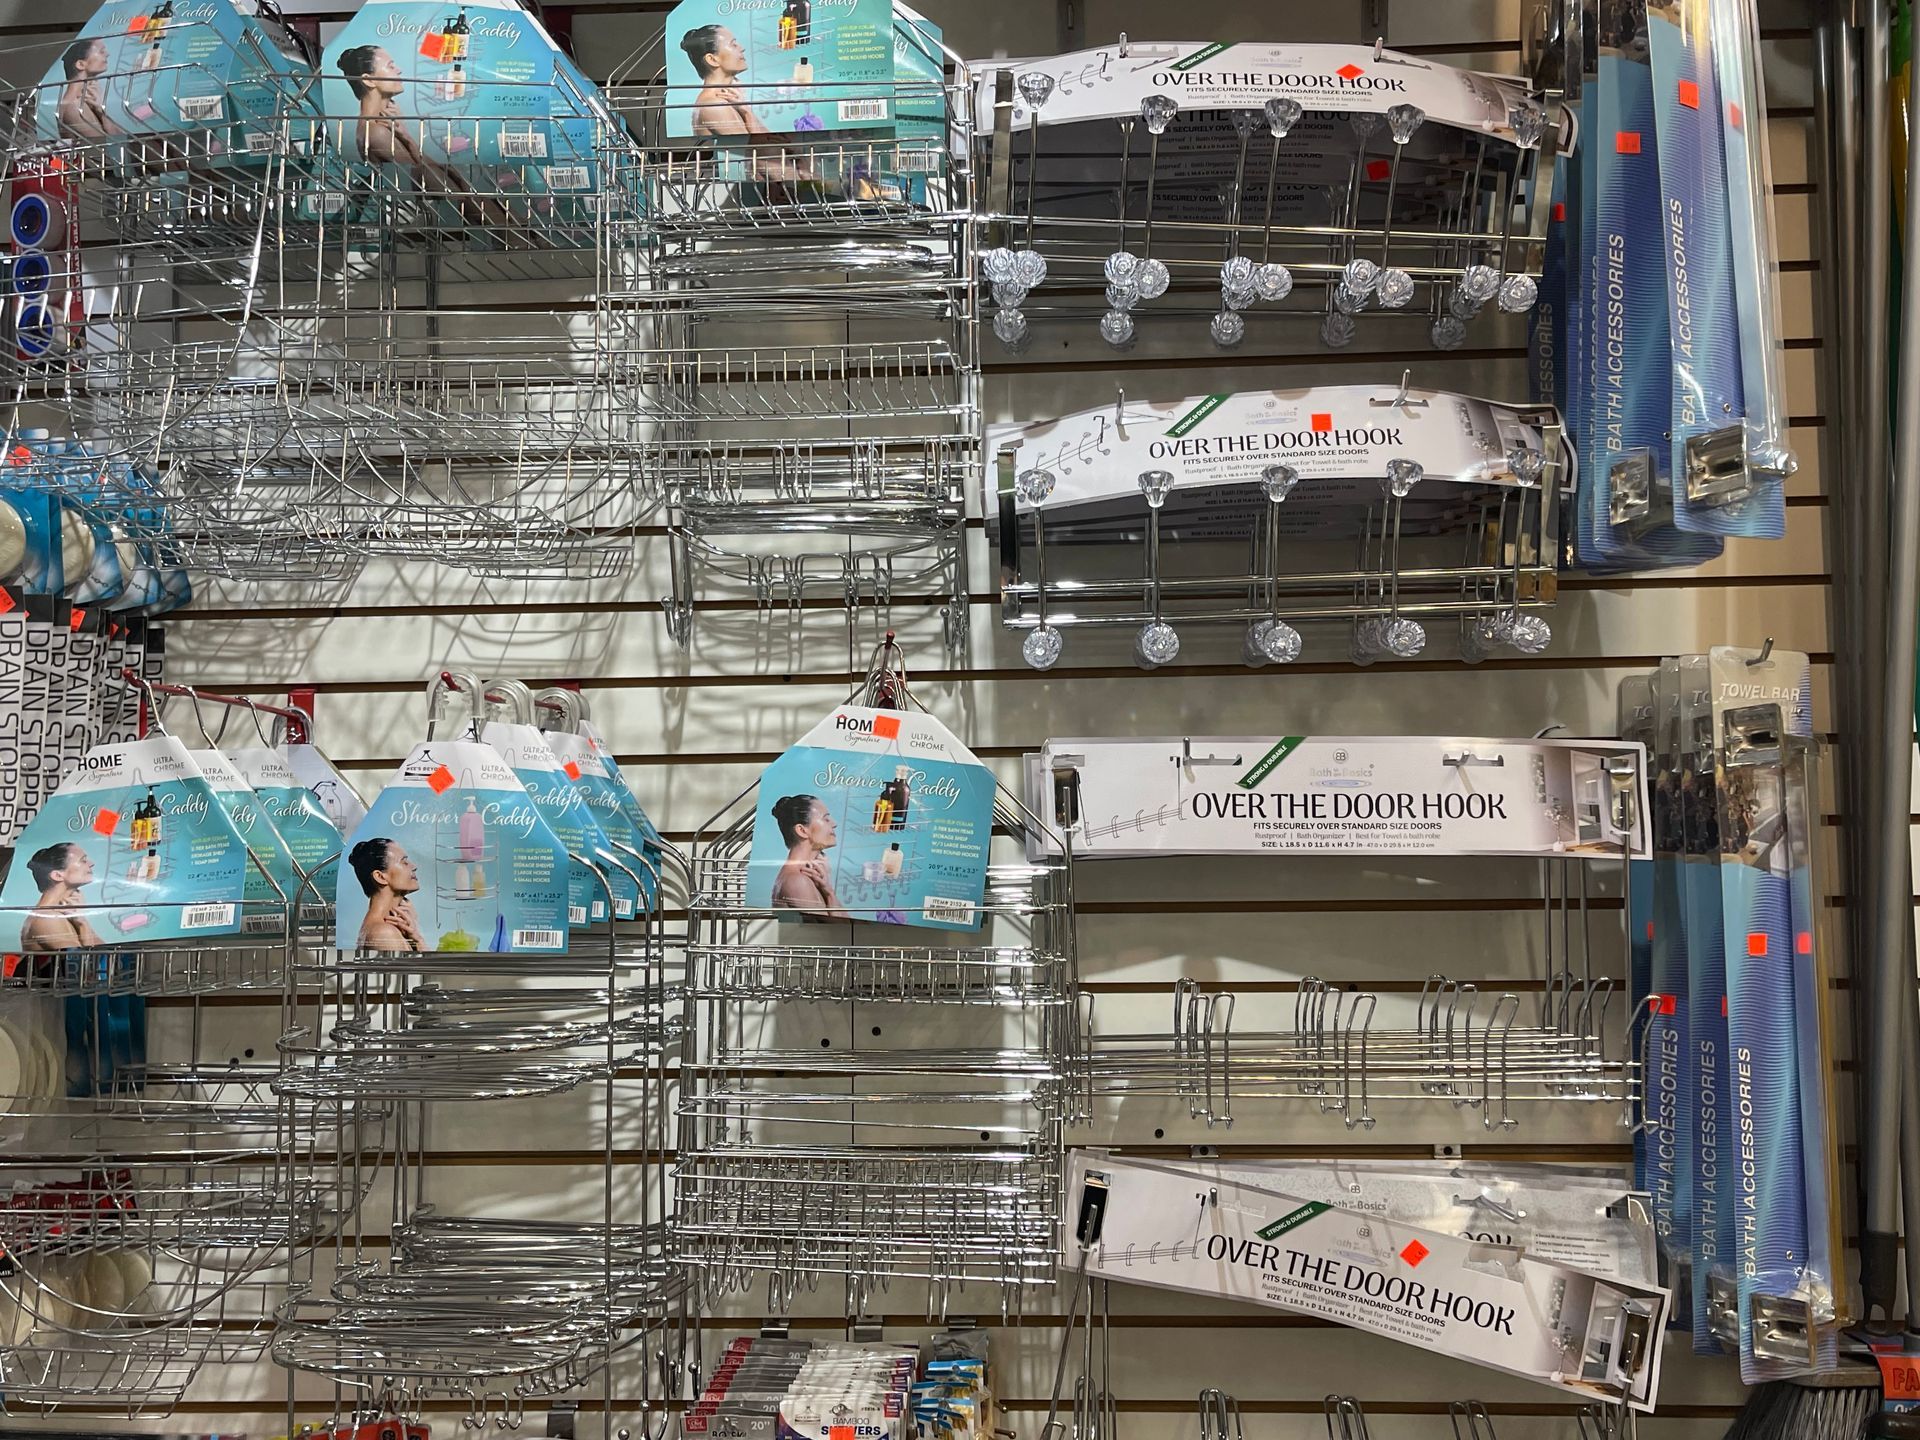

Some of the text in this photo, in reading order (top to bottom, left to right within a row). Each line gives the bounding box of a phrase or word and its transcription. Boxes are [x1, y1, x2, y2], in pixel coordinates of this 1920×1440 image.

[469, 16, 521, 49] Caddy
[1152, 72, 1407, 92] OVER THE DOOR HOOK
[1669, 198, 1696, 425] BATH ACCESSORIES
[1607, 233, 1625, 451] BATH ACCESSORIES
[1175, 398, 1218, 434] STRONG DURABLE
[1149, 428, 1403, 458] OVER THE DOOR HOOK
[1203, 455, 1244, 464] SECURELY
[1271, 451, 1316, 459] STANDARD
[1185, 466, 1217, 474] Rustproof
[66, 639, 94, 716] DRAIN
[1721, 682, 1767, 699] TOWEL
[1771, 687, 1800, 701] BAR
[15, 629, 50, 836] DRAIN STOPPE
[836, 716, 873, 732] HOM
[844, 732, 881, 746] Signature
[911, 733, 934, 741] ULTRA
[153, 756, 175, 764] ULTRA
[910, 740, 944, 751] CHROME
[78, 754, 122, 771] HOME
[88, 770, 123, 785] Signature
[153, 762, 185, 773] CHROME
[261, 764, 284, 772] ULTRA
[481, 772, 516, 781] CHROME
[482, 764, 505, 773] ULTRA
[1246, 745, 1288, 785] STRONG DURABLE
[814, 762, 961, 810] Shower Caddy
[68, 793, 209, 832] Sher Caddy
[264, 797, 311, 828] Caddy
[391, 800, 537, 839] Shower Caddy
[1192, 793, 1507, 819] OVER THE DOOR HOOK
[1657, 1028, 1679, 1236] BATH ACCESSORIES
[1701, 1040, 1717, 1257] BATH ACCESSORIES
[1738, 1047, 1757, 1279] BATH ACCESSORIES
[1266, 1207, 1315, 1237] STRONG DURABLE
[1207, 1234, 1515, 1336] OVER THE DOOR HOOK
[1266, 1293, 1282, 1301] SIZE:
[1262, 1273, 1446, 1328] FITS SECURELY OVER STANDARD SIZE DOORS
[1262, 1283, 1293, 1295] Rustproof
[1302, 1292, 1317, 1301] Bath
[1359, 1307, 1374, 1317] Best
[1374, 1311, 1384, 1319] for
[1385, 1314, 1405, 1325] Towel
[1410, 1321, 1425, 1330] bath
[1426, 1325, 1442, 1336] robe
[821, 1426, 881, 1435] SERS
